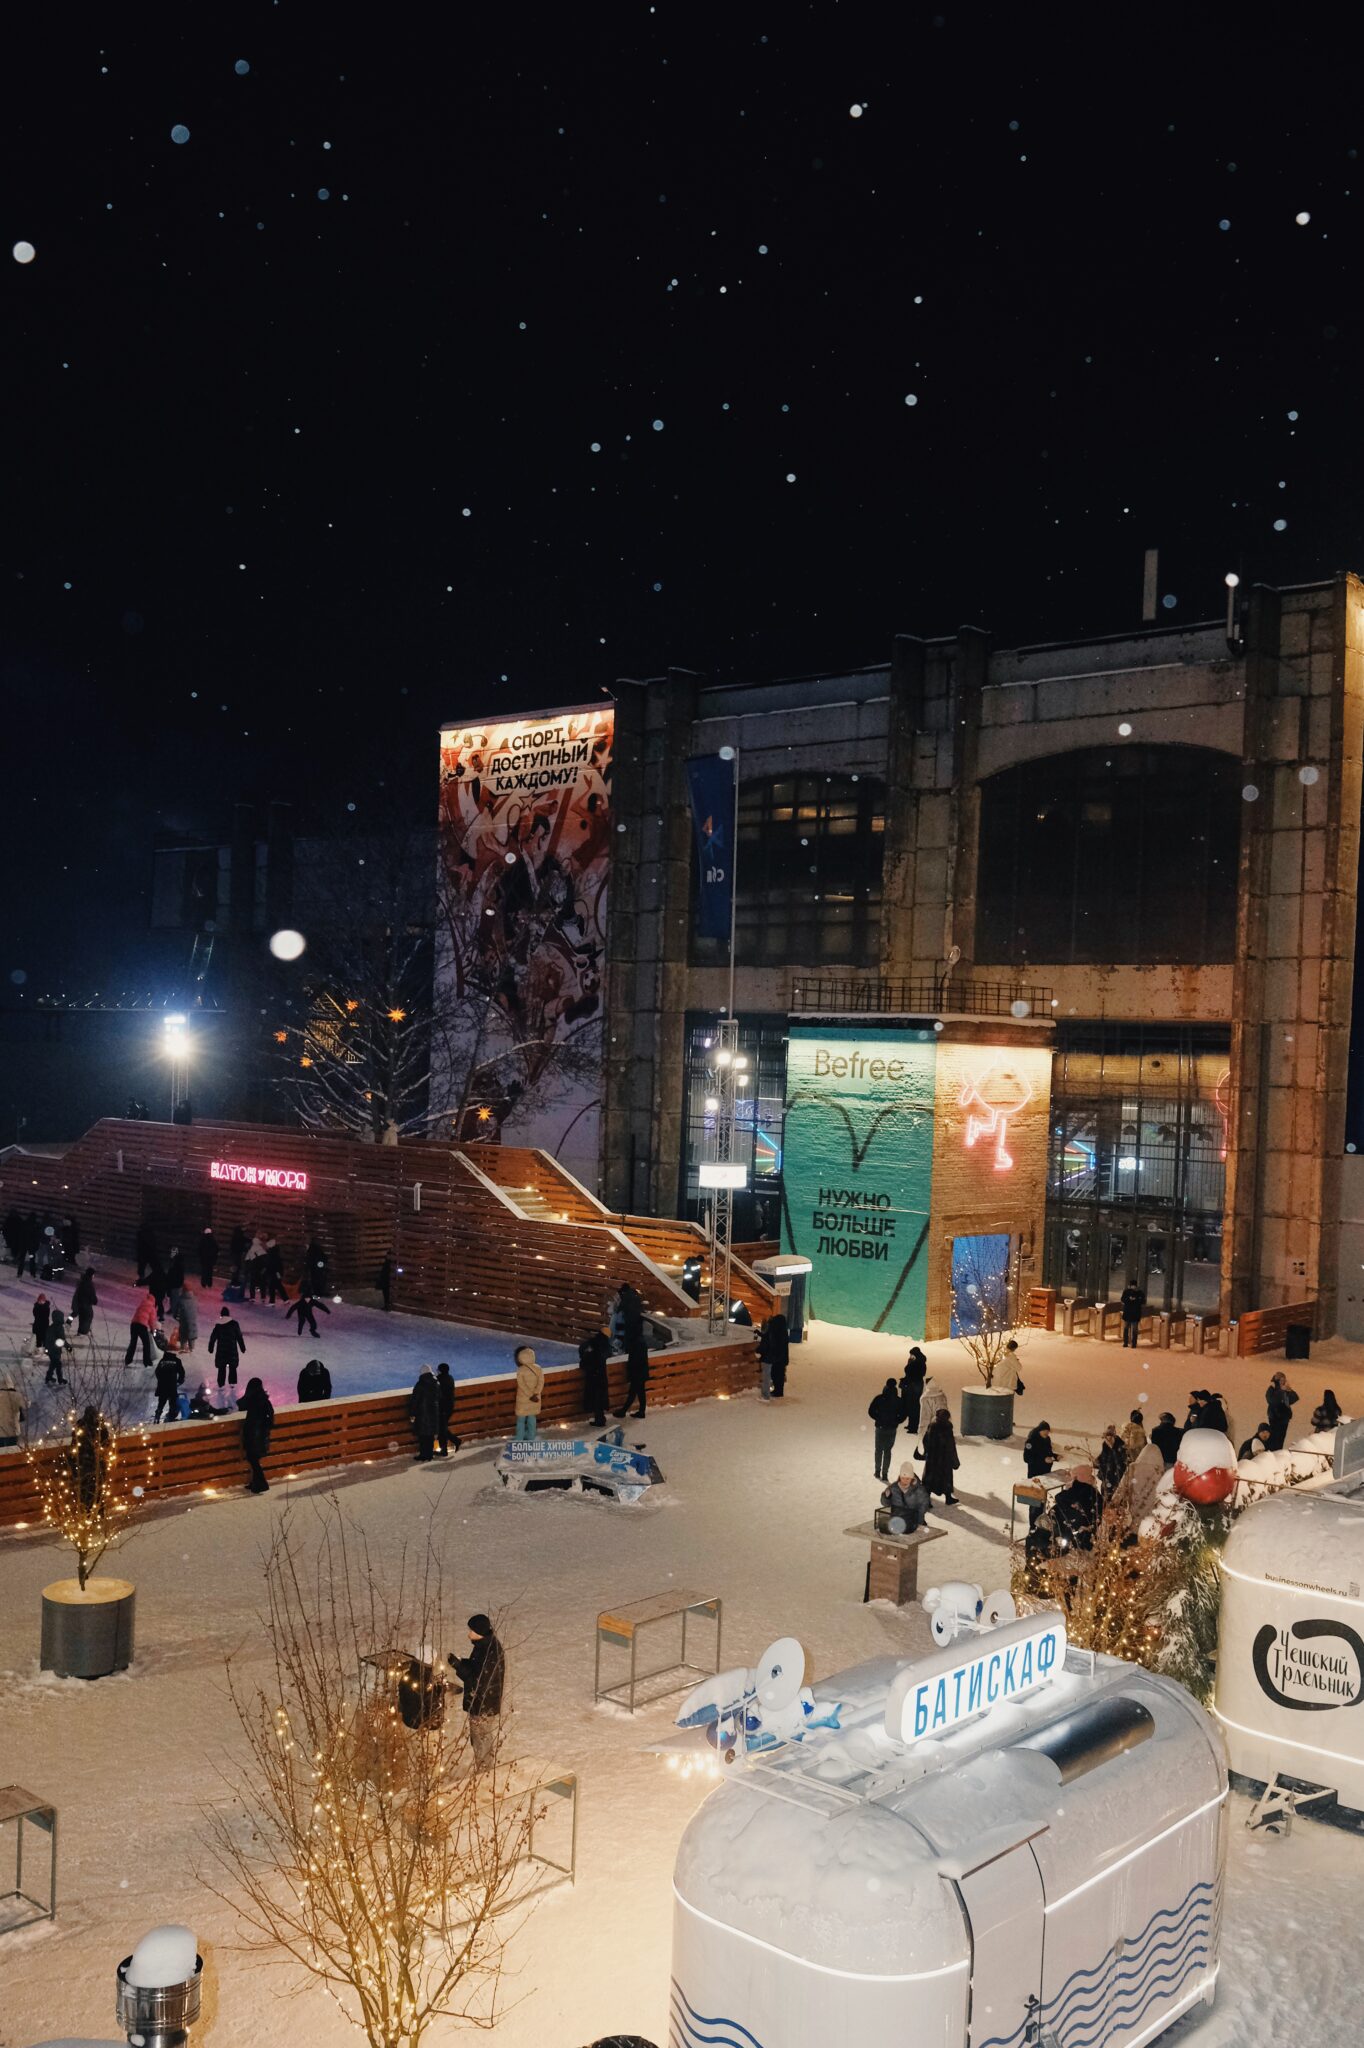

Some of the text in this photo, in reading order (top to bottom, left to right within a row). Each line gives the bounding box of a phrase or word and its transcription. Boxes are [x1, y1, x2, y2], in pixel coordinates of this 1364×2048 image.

[512, 727, 565, 751] СПОРТ,
[491, 738, 589, 775] ДОСТУПНЫЙ
[496, 766, 578, 791] КАЖДОМУ!
[815, 1048, 904, 1081] Befree
[264, 1168, 307, 1190] МОРЯ
[818, 1187, 891, 1213] НУЖНО
[812, 1211, 896, 1238] БОЛЬШЕ
[816, 1236, 889, 1261] ЛЮБВИ
[511, 1441, 575, 1452] БОЛЬШЕ ХИТОВ!
[1264, 1572, 1348, 1597] businessonwheels.ru
[1280, 1629, 1348, 1676] Чешский
[914, 1632, 1057, 1738] БАТИСКАФ
[1273, 1647, 1355, 1699] Трдельник
